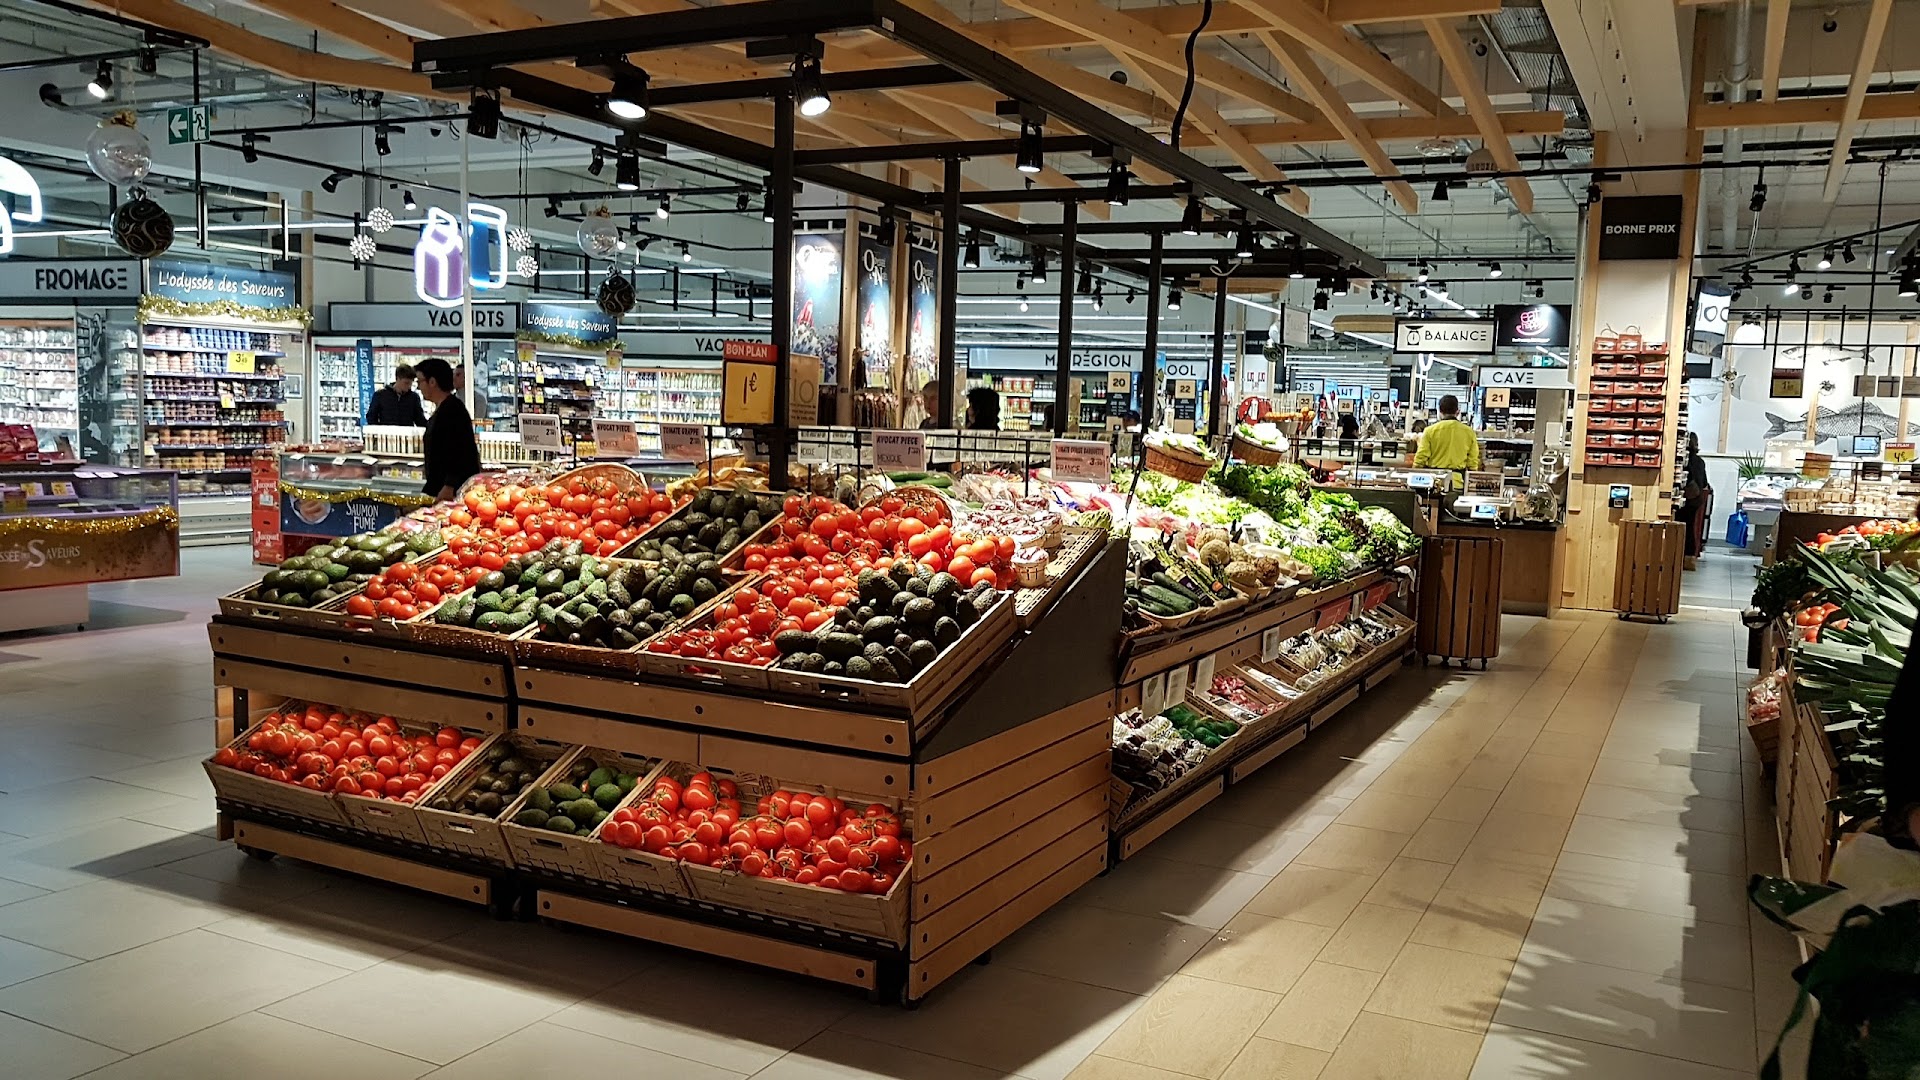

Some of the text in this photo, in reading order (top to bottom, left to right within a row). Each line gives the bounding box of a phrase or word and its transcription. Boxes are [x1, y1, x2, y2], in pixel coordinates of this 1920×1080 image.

[1605, 224, 1676, 234] BORNE PRIX
[35, 268, 128, 290] FROMAGE
[158, 271, 286, 298] L'odyssée des Saveurs
[428, 310, 504, 327] YAORTS
[527, 313, 564, 329] L'odyssée
[580, 319, 611, 333] Saveurs
[1424, 330, 1487, 341] BALANCE
[726, 343, 745, 356] BON
[746, 345, 768, 358] PLAN
[1045, 350, 1132, 367] M RÉGION
[1112, 378, 1126, 387] 20
[1492, 372, 1534, 384] CAVE
[1179, 385, 1191, 393] 22
[1491, 394, 1504, 402] 21
[876, 436, 899, 444] AVOCAT
